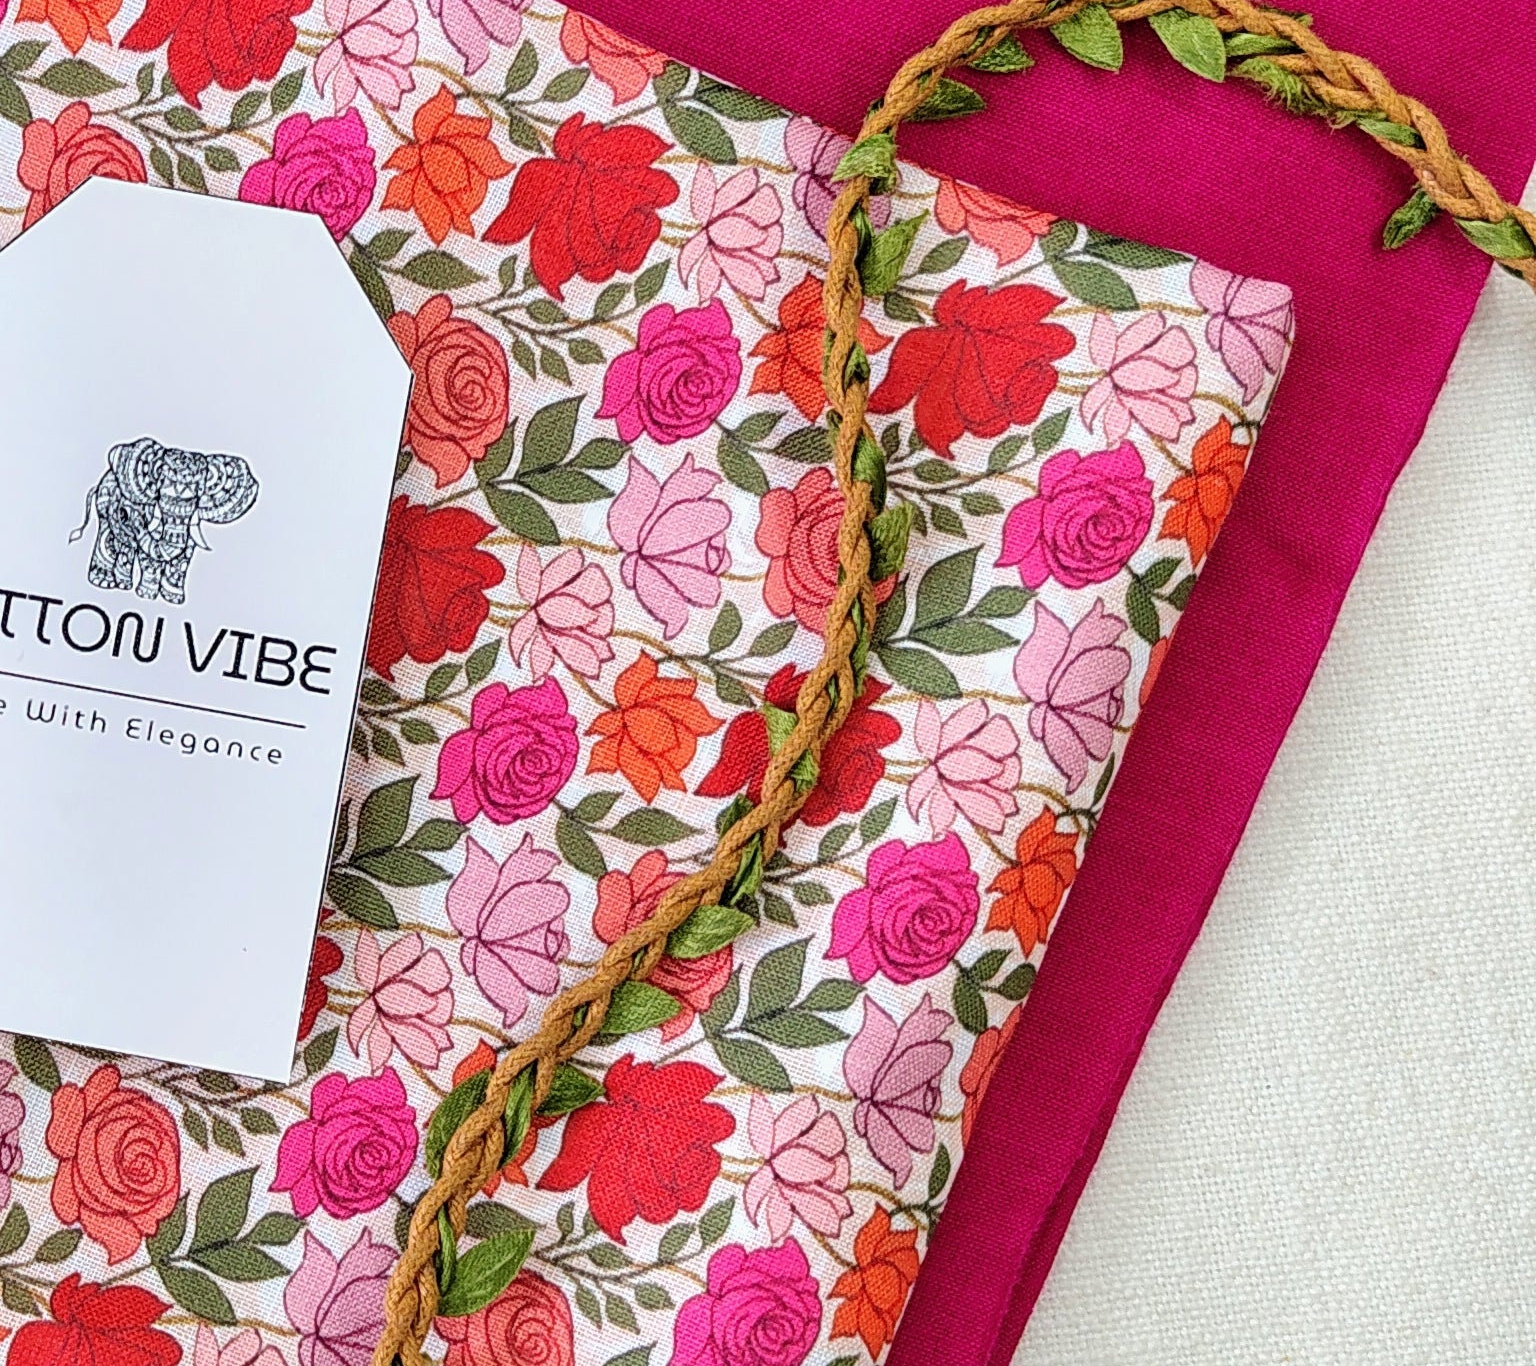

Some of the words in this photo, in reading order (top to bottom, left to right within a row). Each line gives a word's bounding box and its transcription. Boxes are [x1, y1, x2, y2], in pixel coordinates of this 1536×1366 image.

[183, 621, 337, 695] VIBE
[26, 699, 107, 734] With
[125, 718, 283, 765] Elegance
